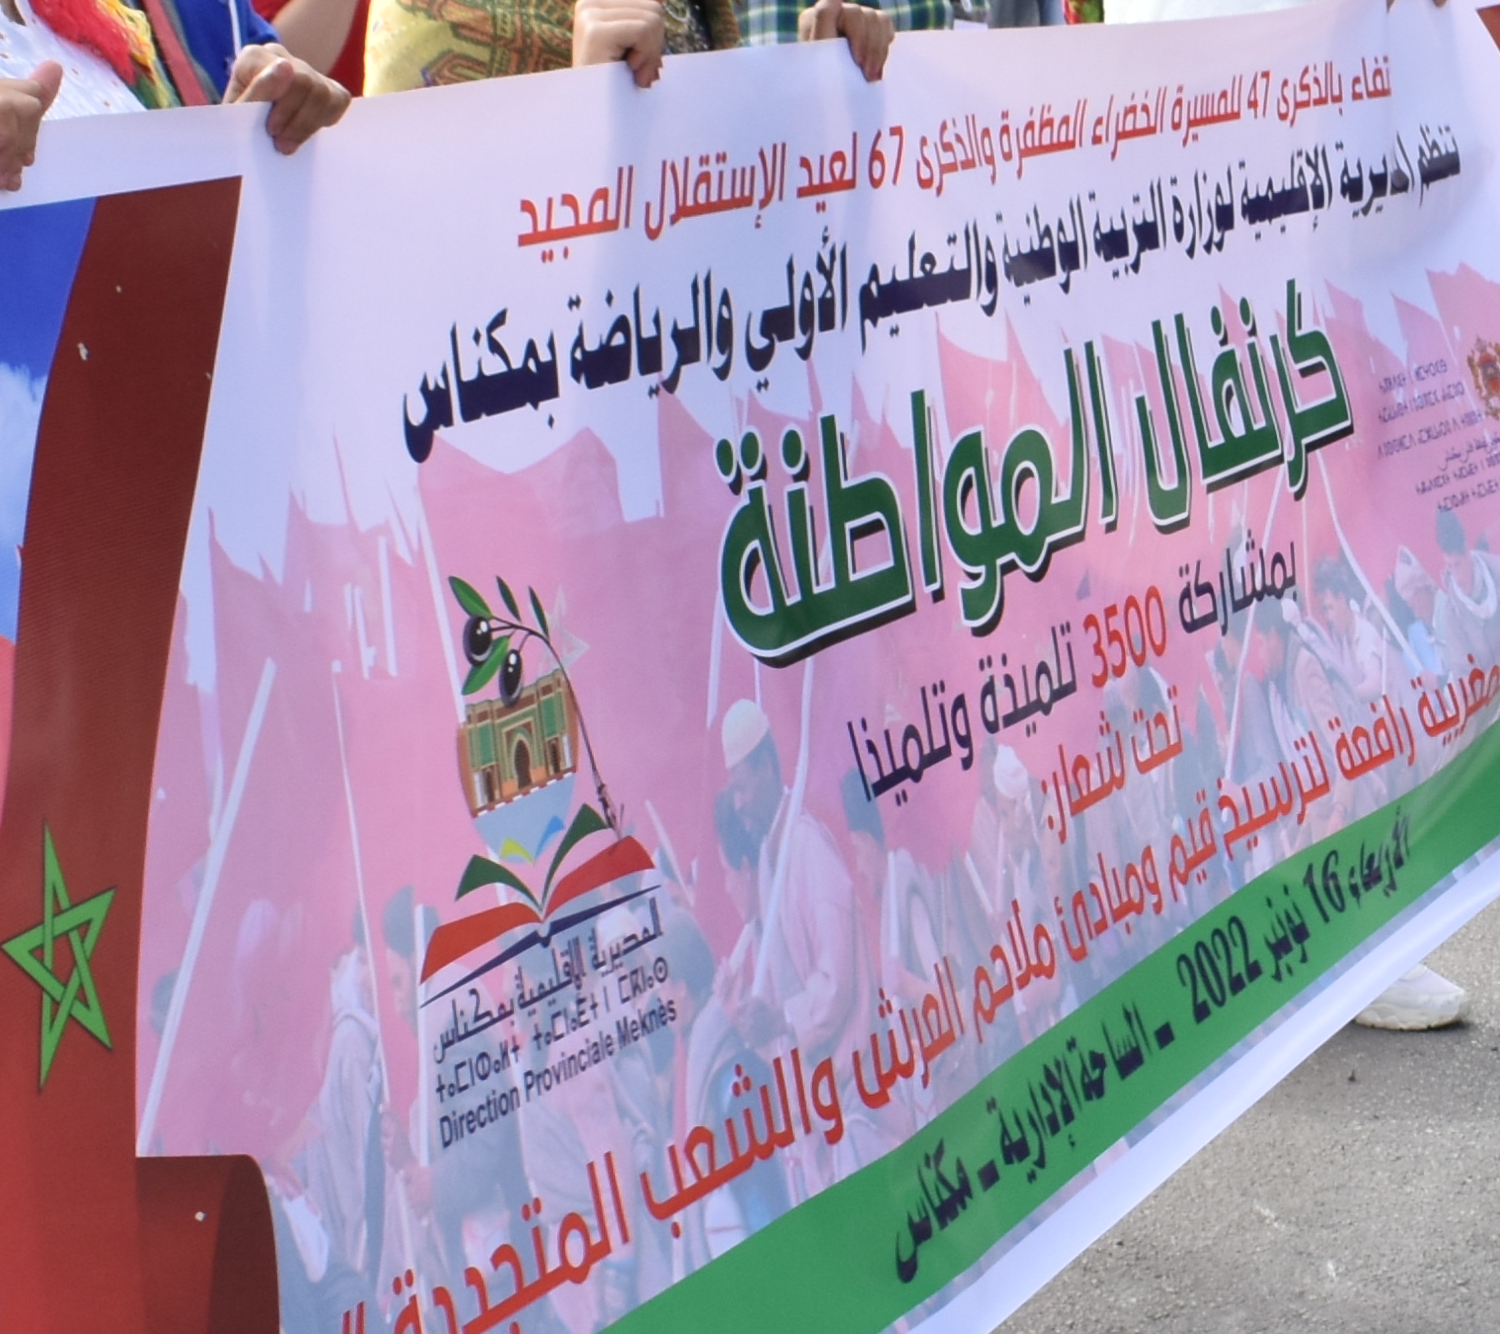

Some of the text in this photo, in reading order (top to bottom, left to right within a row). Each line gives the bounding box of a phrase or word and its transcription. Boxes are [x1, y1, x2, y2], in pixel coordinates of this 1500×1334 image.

[999, 99, 1087, 180] المظفرة
[1092, 86, 1167, 161] الخضراء
[1171, 74, 1243, 147] للمسيرة
[1247, 70, 1271, 119] 47
[1276, 60, 1343, 128] بالذكرى
[644, 141, 787, 241] الإستقلال
[796, 132, 858, 213] لعيد
[868, 125, 904, 189] 67
[915, 113, 997, 196] والذكرى
[1240, 142, 1332, 241] الإقليمية
[1416, 123, 1461, 209] تنظم
[517, 165, 634, 262] المجيد
[996, 194, 1088, 305] الوطنية
[1088, 176, 1166, 279] التربية
[1170, 164, 1235, 260] لوزارة
[567, 267, 733, 398] والرياضة
[745, 226, 848, 392] الأولي
[858, 218, 999, 356] والتعليم
[403, 307, 560, 463] بمكناس
[712, 277, 1355, 667] كرنفال المواطنة
[847, 528, 1298, 806] بمشاركة 3500 تلميذة وتلميذا
[1132, 685, 1183, 774] تحت
[1328, 694, 1416, 781] رافعة
[1168, 788, 1217, 903] قيم
[1217, 731, 1330, 860] لترسيخ
[1054, 844, 1163, 963] ومبادئ
[1303, 849, 1346, 925] 16
[433, 896, 663, 1064] المديرية الإقليمية بمكناس
[973, 899, 1056, 1043] ملاحم
[1176, 915, 1263, 1025] 2022
[440, 997, 677, 1149] Direction Provinciale Meknès
[852, 956, 965, 1109] العرش
[1066, 1001, 1152, 1102] الساحة
[640, 1048, 845, 1238] والشعب
[895, 1137, 974, 1283] مكناس
